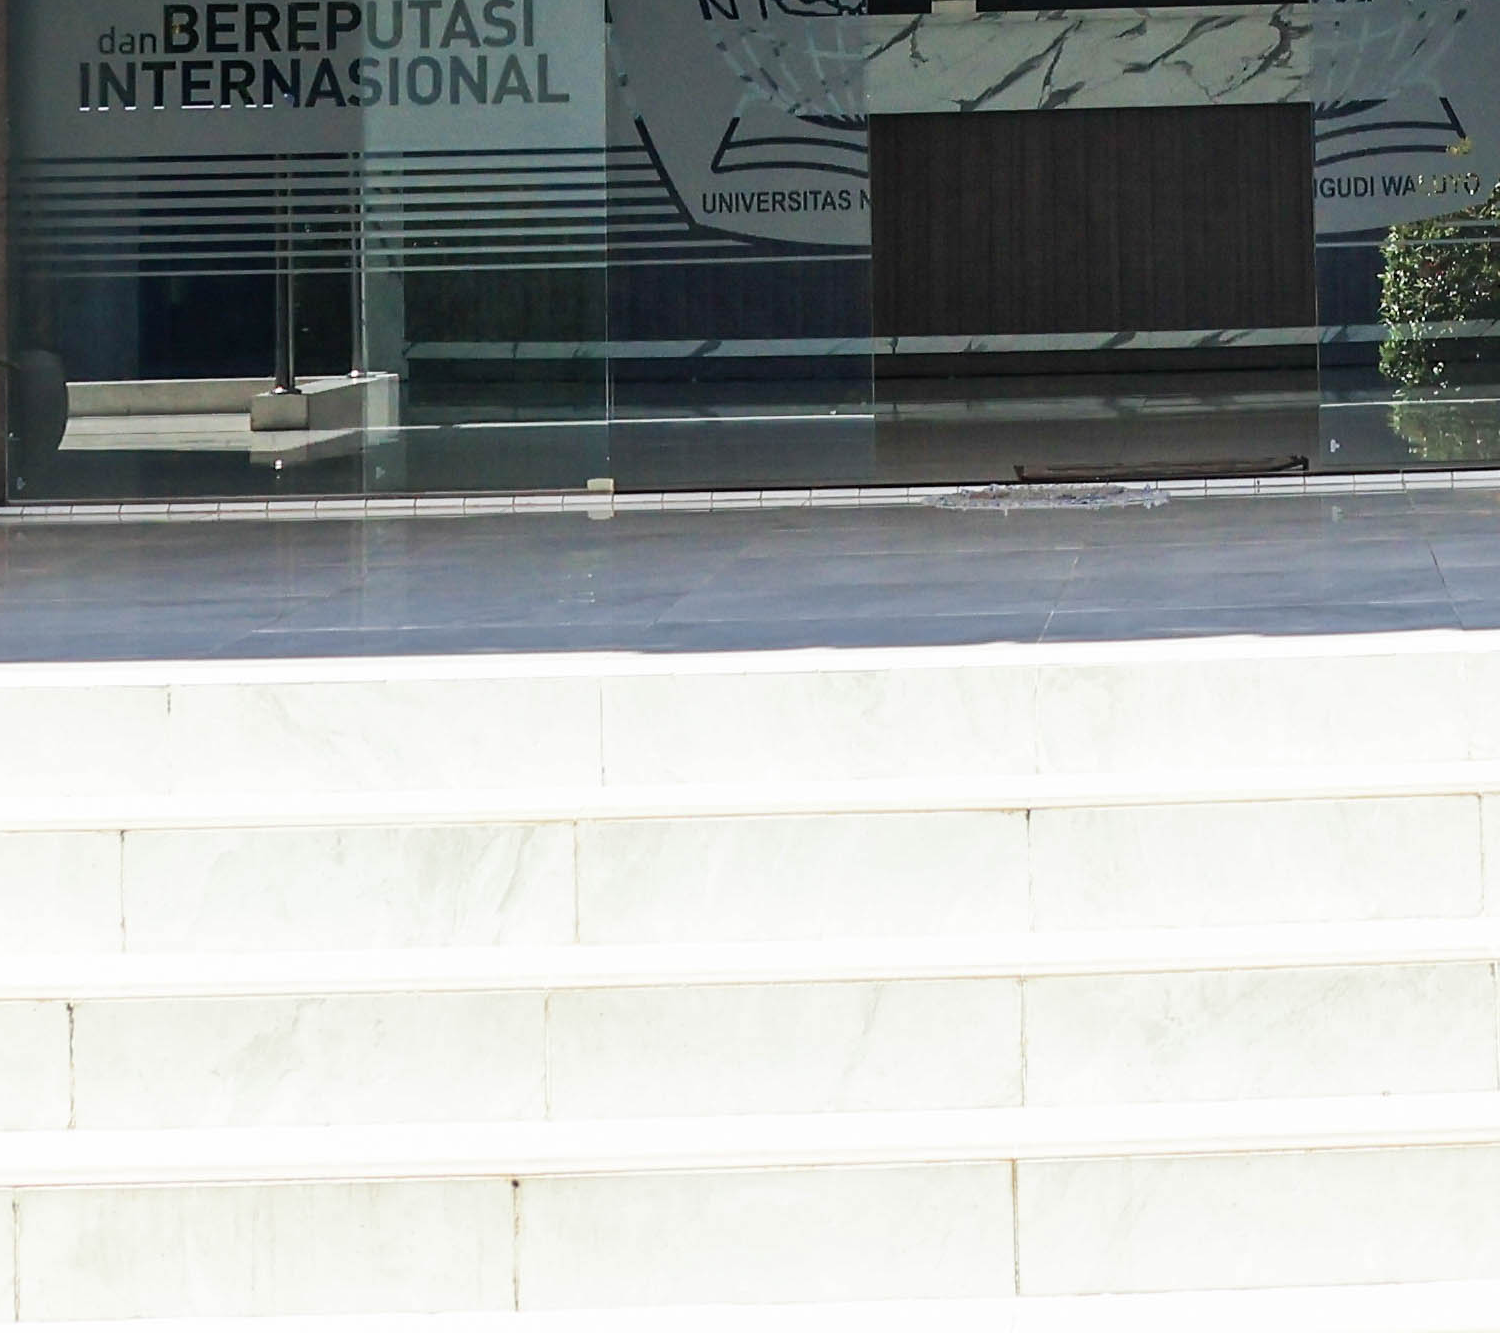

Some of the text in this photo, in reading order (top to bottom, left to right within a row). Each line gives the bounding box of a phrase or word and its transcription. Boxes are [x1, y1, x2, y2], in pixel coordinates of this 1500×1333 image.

[98, 26, 157, 55] dan
[79, 54, 570, 109] INTERNASIONAL
[1313, 176, 1375, 199] GUDI
[702, 190, 851, 214] UNIVERSITAS
